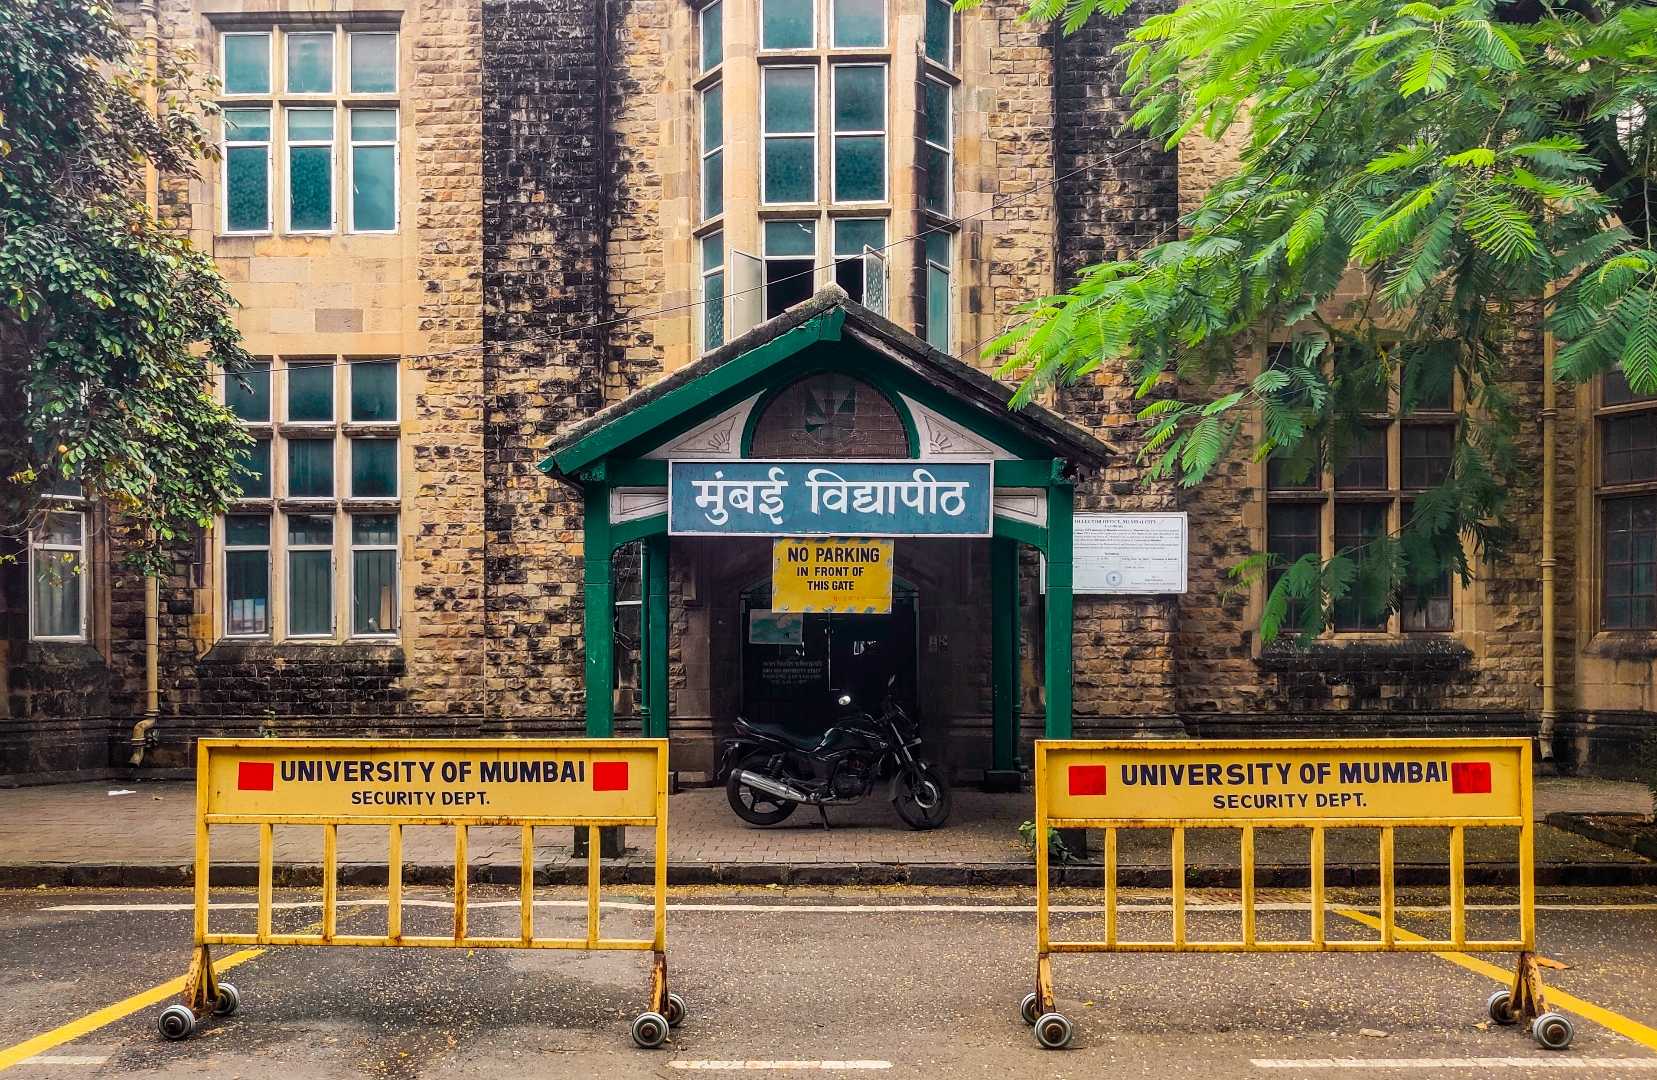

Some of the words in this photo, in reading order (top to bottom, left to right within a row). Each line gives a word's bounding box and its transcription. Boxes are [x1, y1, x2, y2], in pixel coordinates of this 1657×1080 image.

[691, 467, 788, 525] मुंबई
[805, 469, 970, 516] विद्यापीठ
[788, 547, 808, 562] NO
[816, 547, 880, 563] PARKING
[797, 567, 808, 577] IN
[814, 567, 849, 577] FRONT
[852, 567, 865, 577] OF
[807, 580, 829, 591] THIS
[832, 580, 854, 591] GATE
[281, 761, 435, 783] UNIVERSITY
[442, 761, 472, 783] OF
[480, 761, 585, 783] MUMBAI
[1121, 763, 1292, 786] UNIVERSITY
[1299, 762, 1332, 785] OF
[1340, 761, 1448, 784] MUMBAI
[351, 791, 435, 805] SECURITY
[442, 791, 490, 806] DEPT.
[1213, 793, 1308, 809] SECURITY
[1316, 792, 1367, 808] DEPT.
